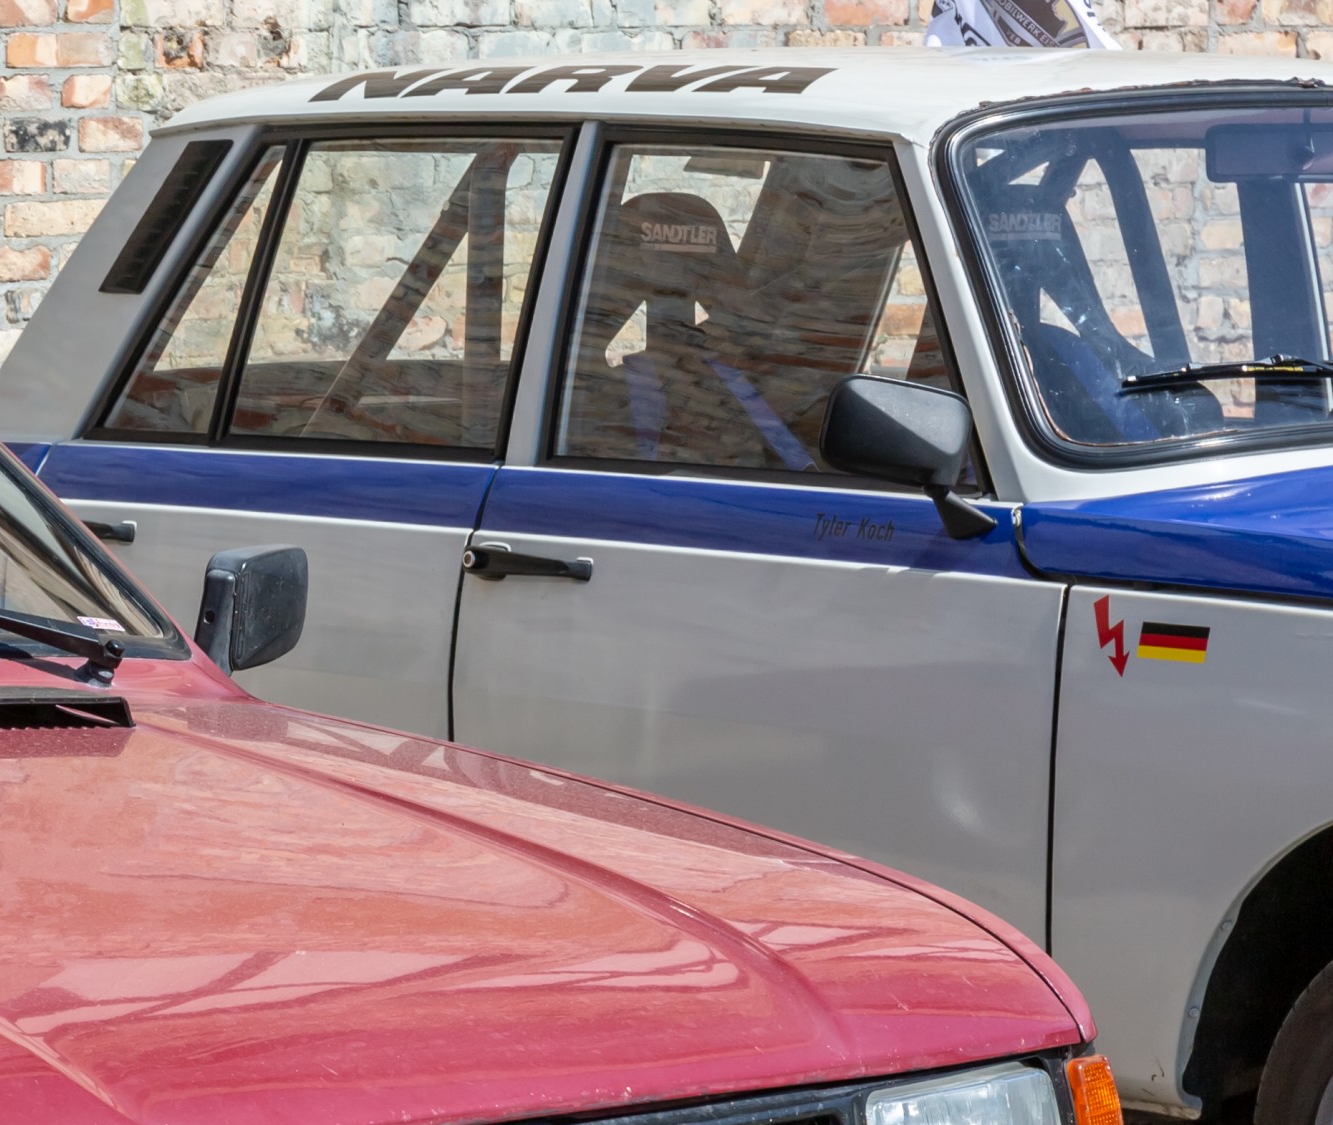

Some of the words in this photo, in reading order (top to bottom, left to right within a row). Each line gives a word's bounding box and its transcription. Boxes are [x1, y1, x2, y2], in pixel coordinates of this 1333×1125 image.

[307, 64, 839, 102] NARVA
[640, 221, 718, 245] SANDTLER
[856, 517, 895, 542] Koch
